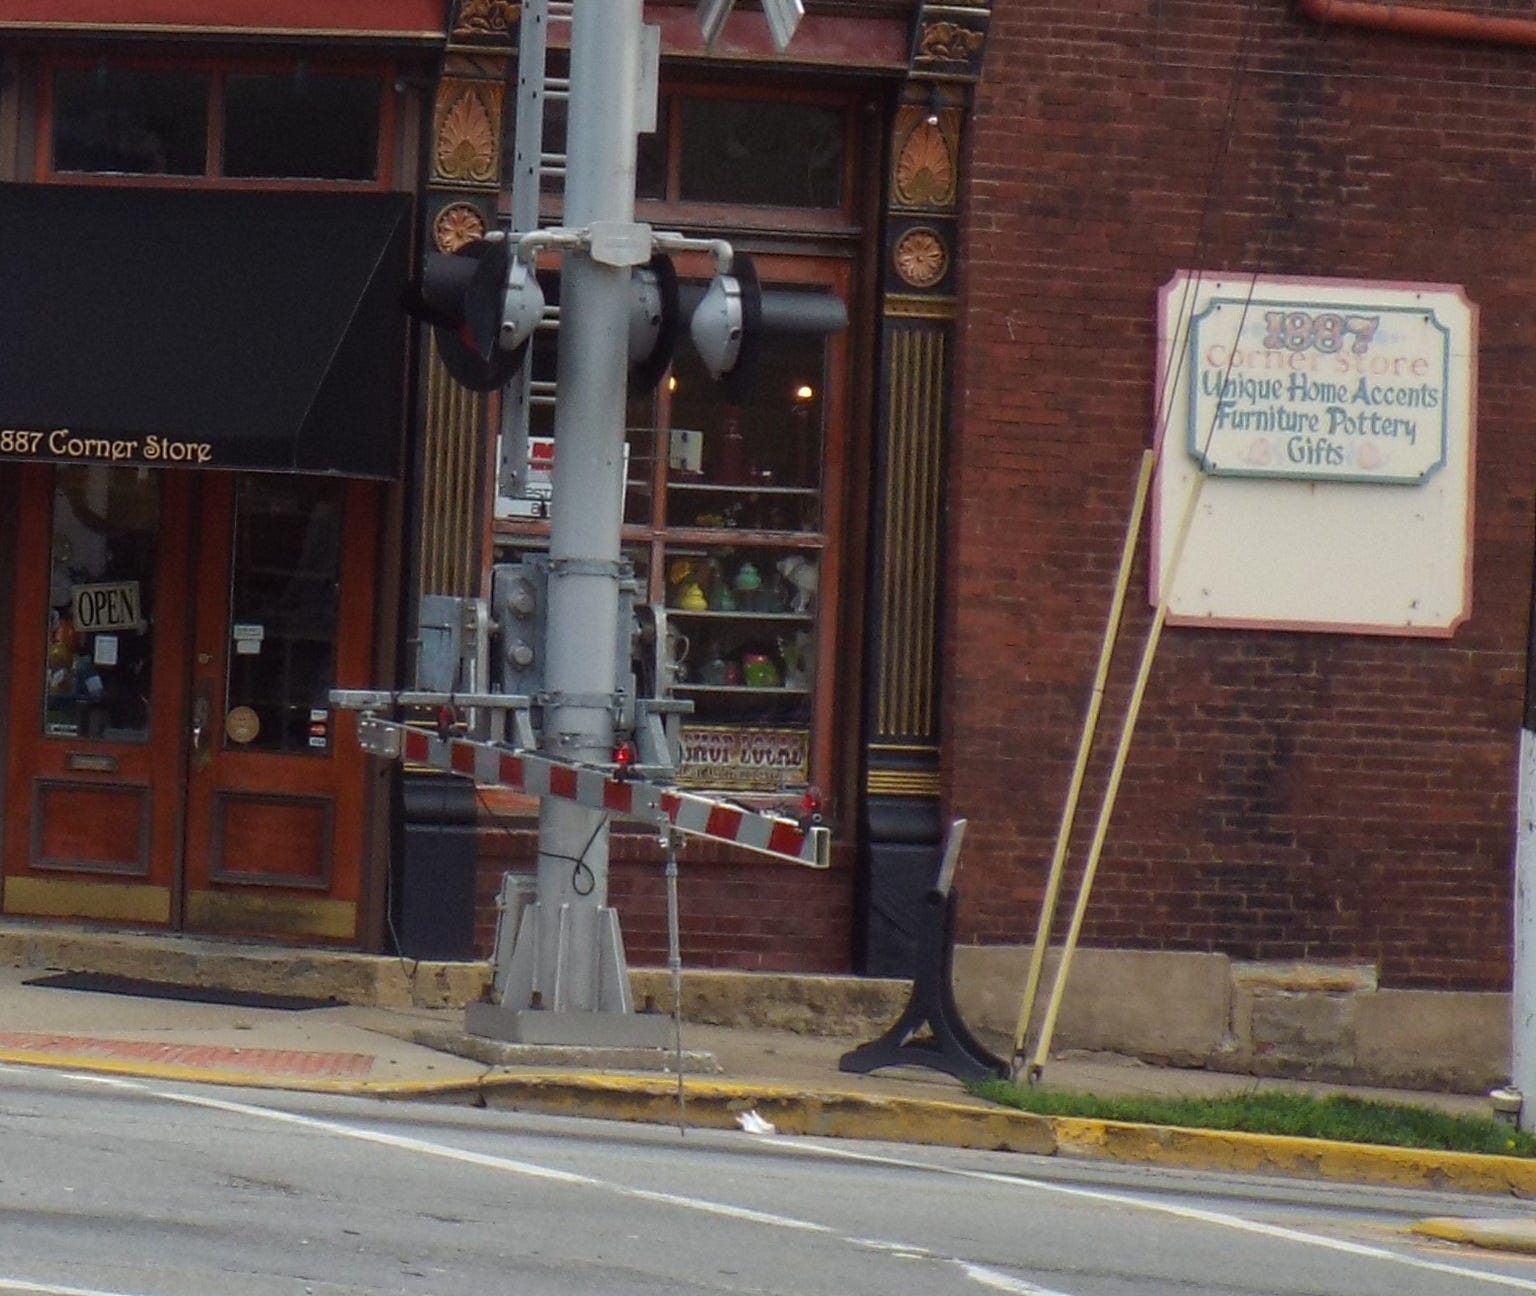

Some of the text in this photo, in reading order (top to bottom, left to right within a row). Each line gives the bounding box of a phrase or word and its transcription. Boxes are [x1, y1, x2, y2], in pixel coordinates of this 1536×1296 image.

[1263, 311, 1380, 354] 1887
[1207, 344, 1320, 373] Corner
[1202, 370, 1439, 408] Unique Home Accents
[1217, 400, 1416, 446] Furniture Pottery
[49, 429, 138, 461] Corner
[143, 435, 212, 463] Store
[1287, 435, 1344, 465] Gifts
[79, 590, 135, 627] OPEN
